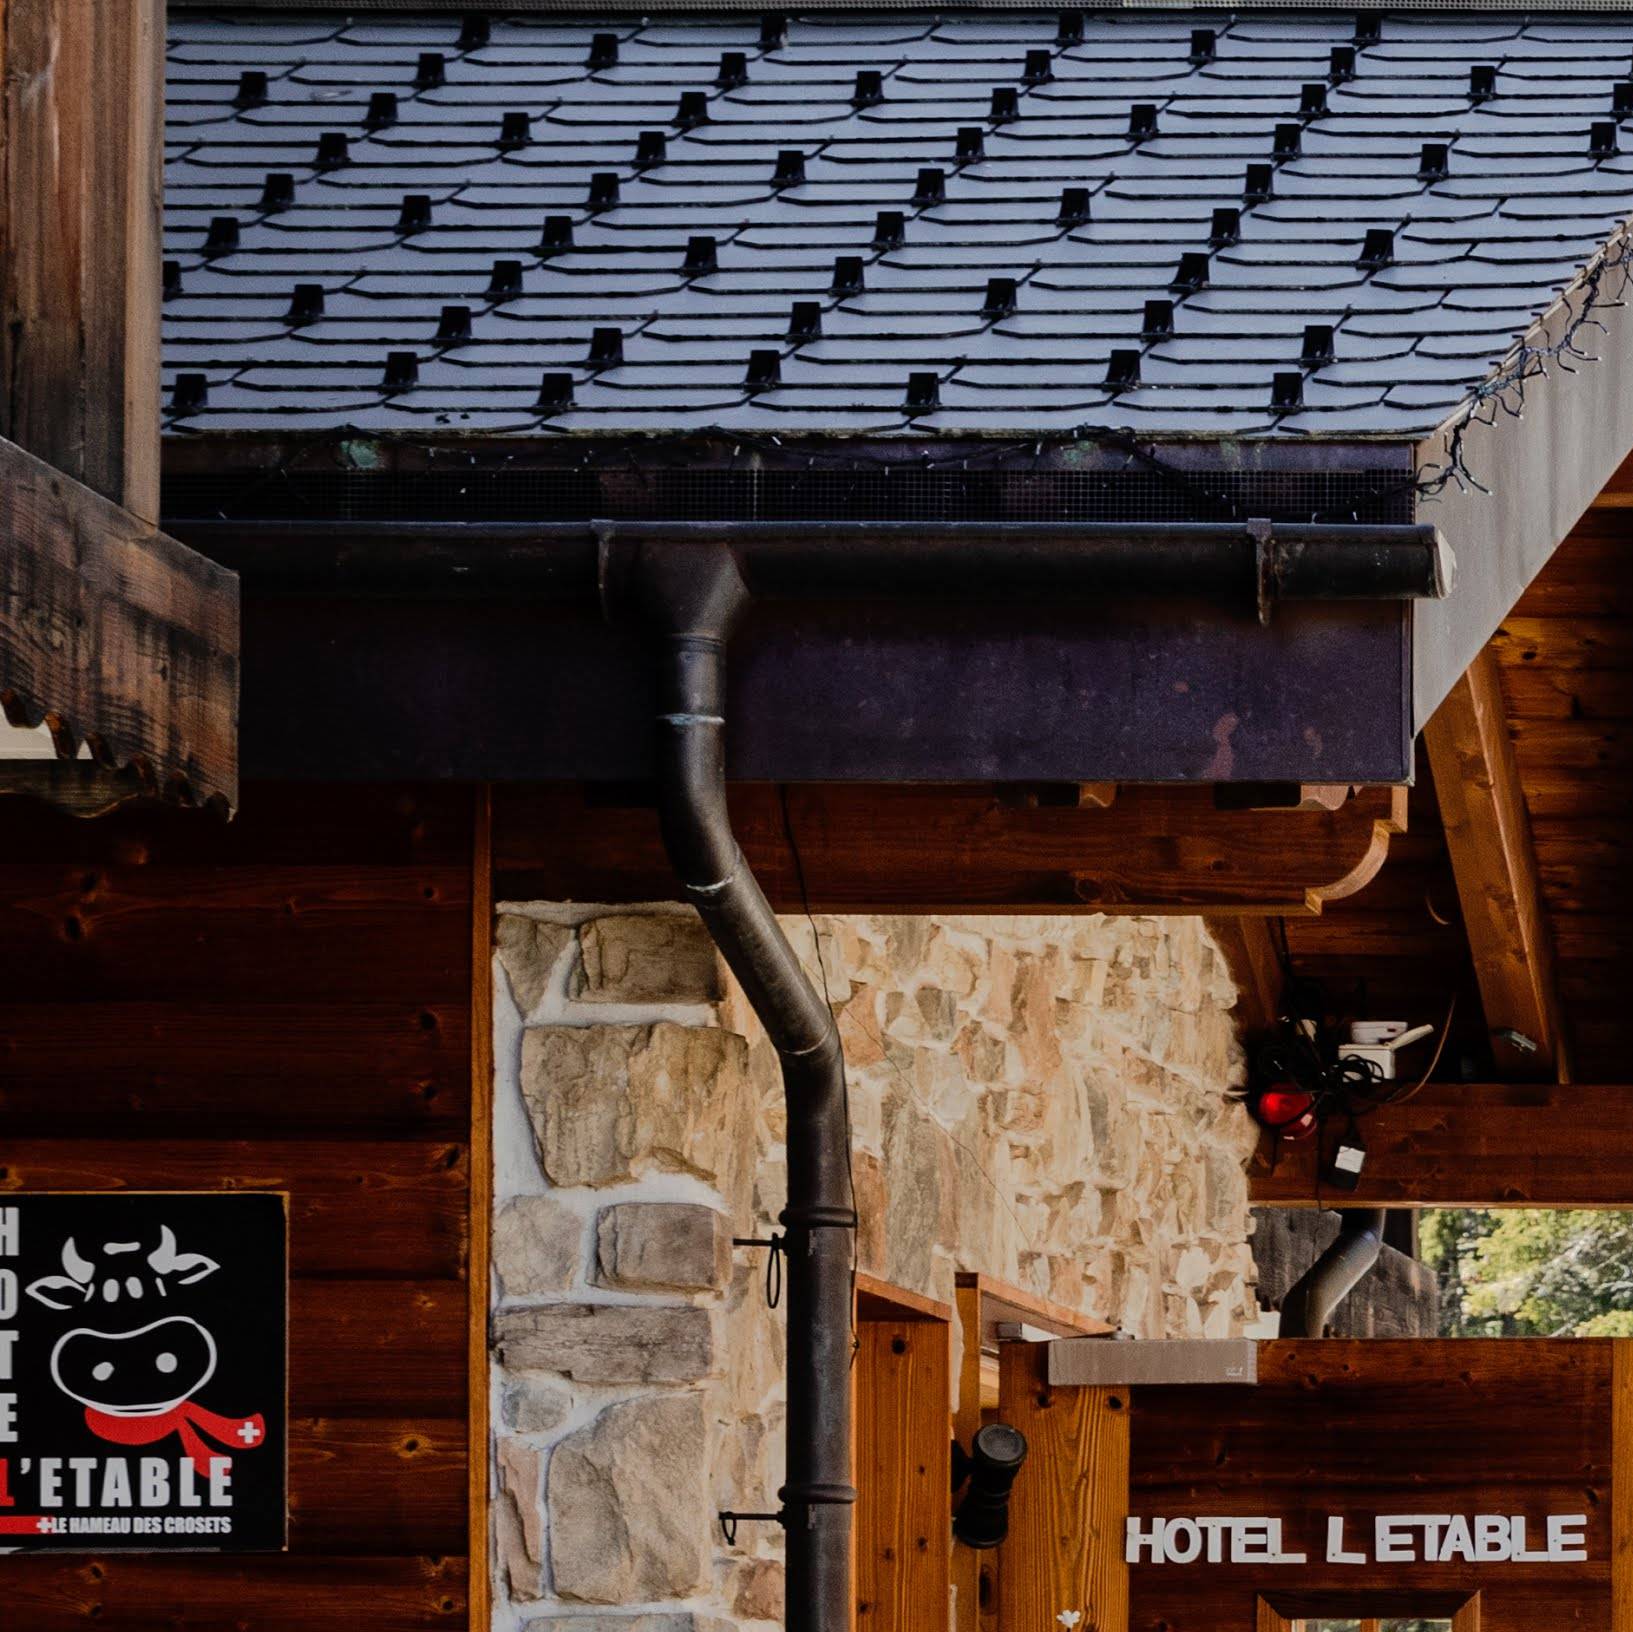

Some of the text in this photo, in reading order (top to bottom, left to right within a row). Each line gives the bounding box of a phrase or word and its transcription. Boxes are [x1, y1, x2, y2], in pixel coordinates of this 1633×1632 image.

[52, 1516, 232, 1534] LE HAMEAU DES CROSETS
[1125, 1516, 1307, 1563] HOTEL
[1375, 1514, 1587, 1562] ETABLE
